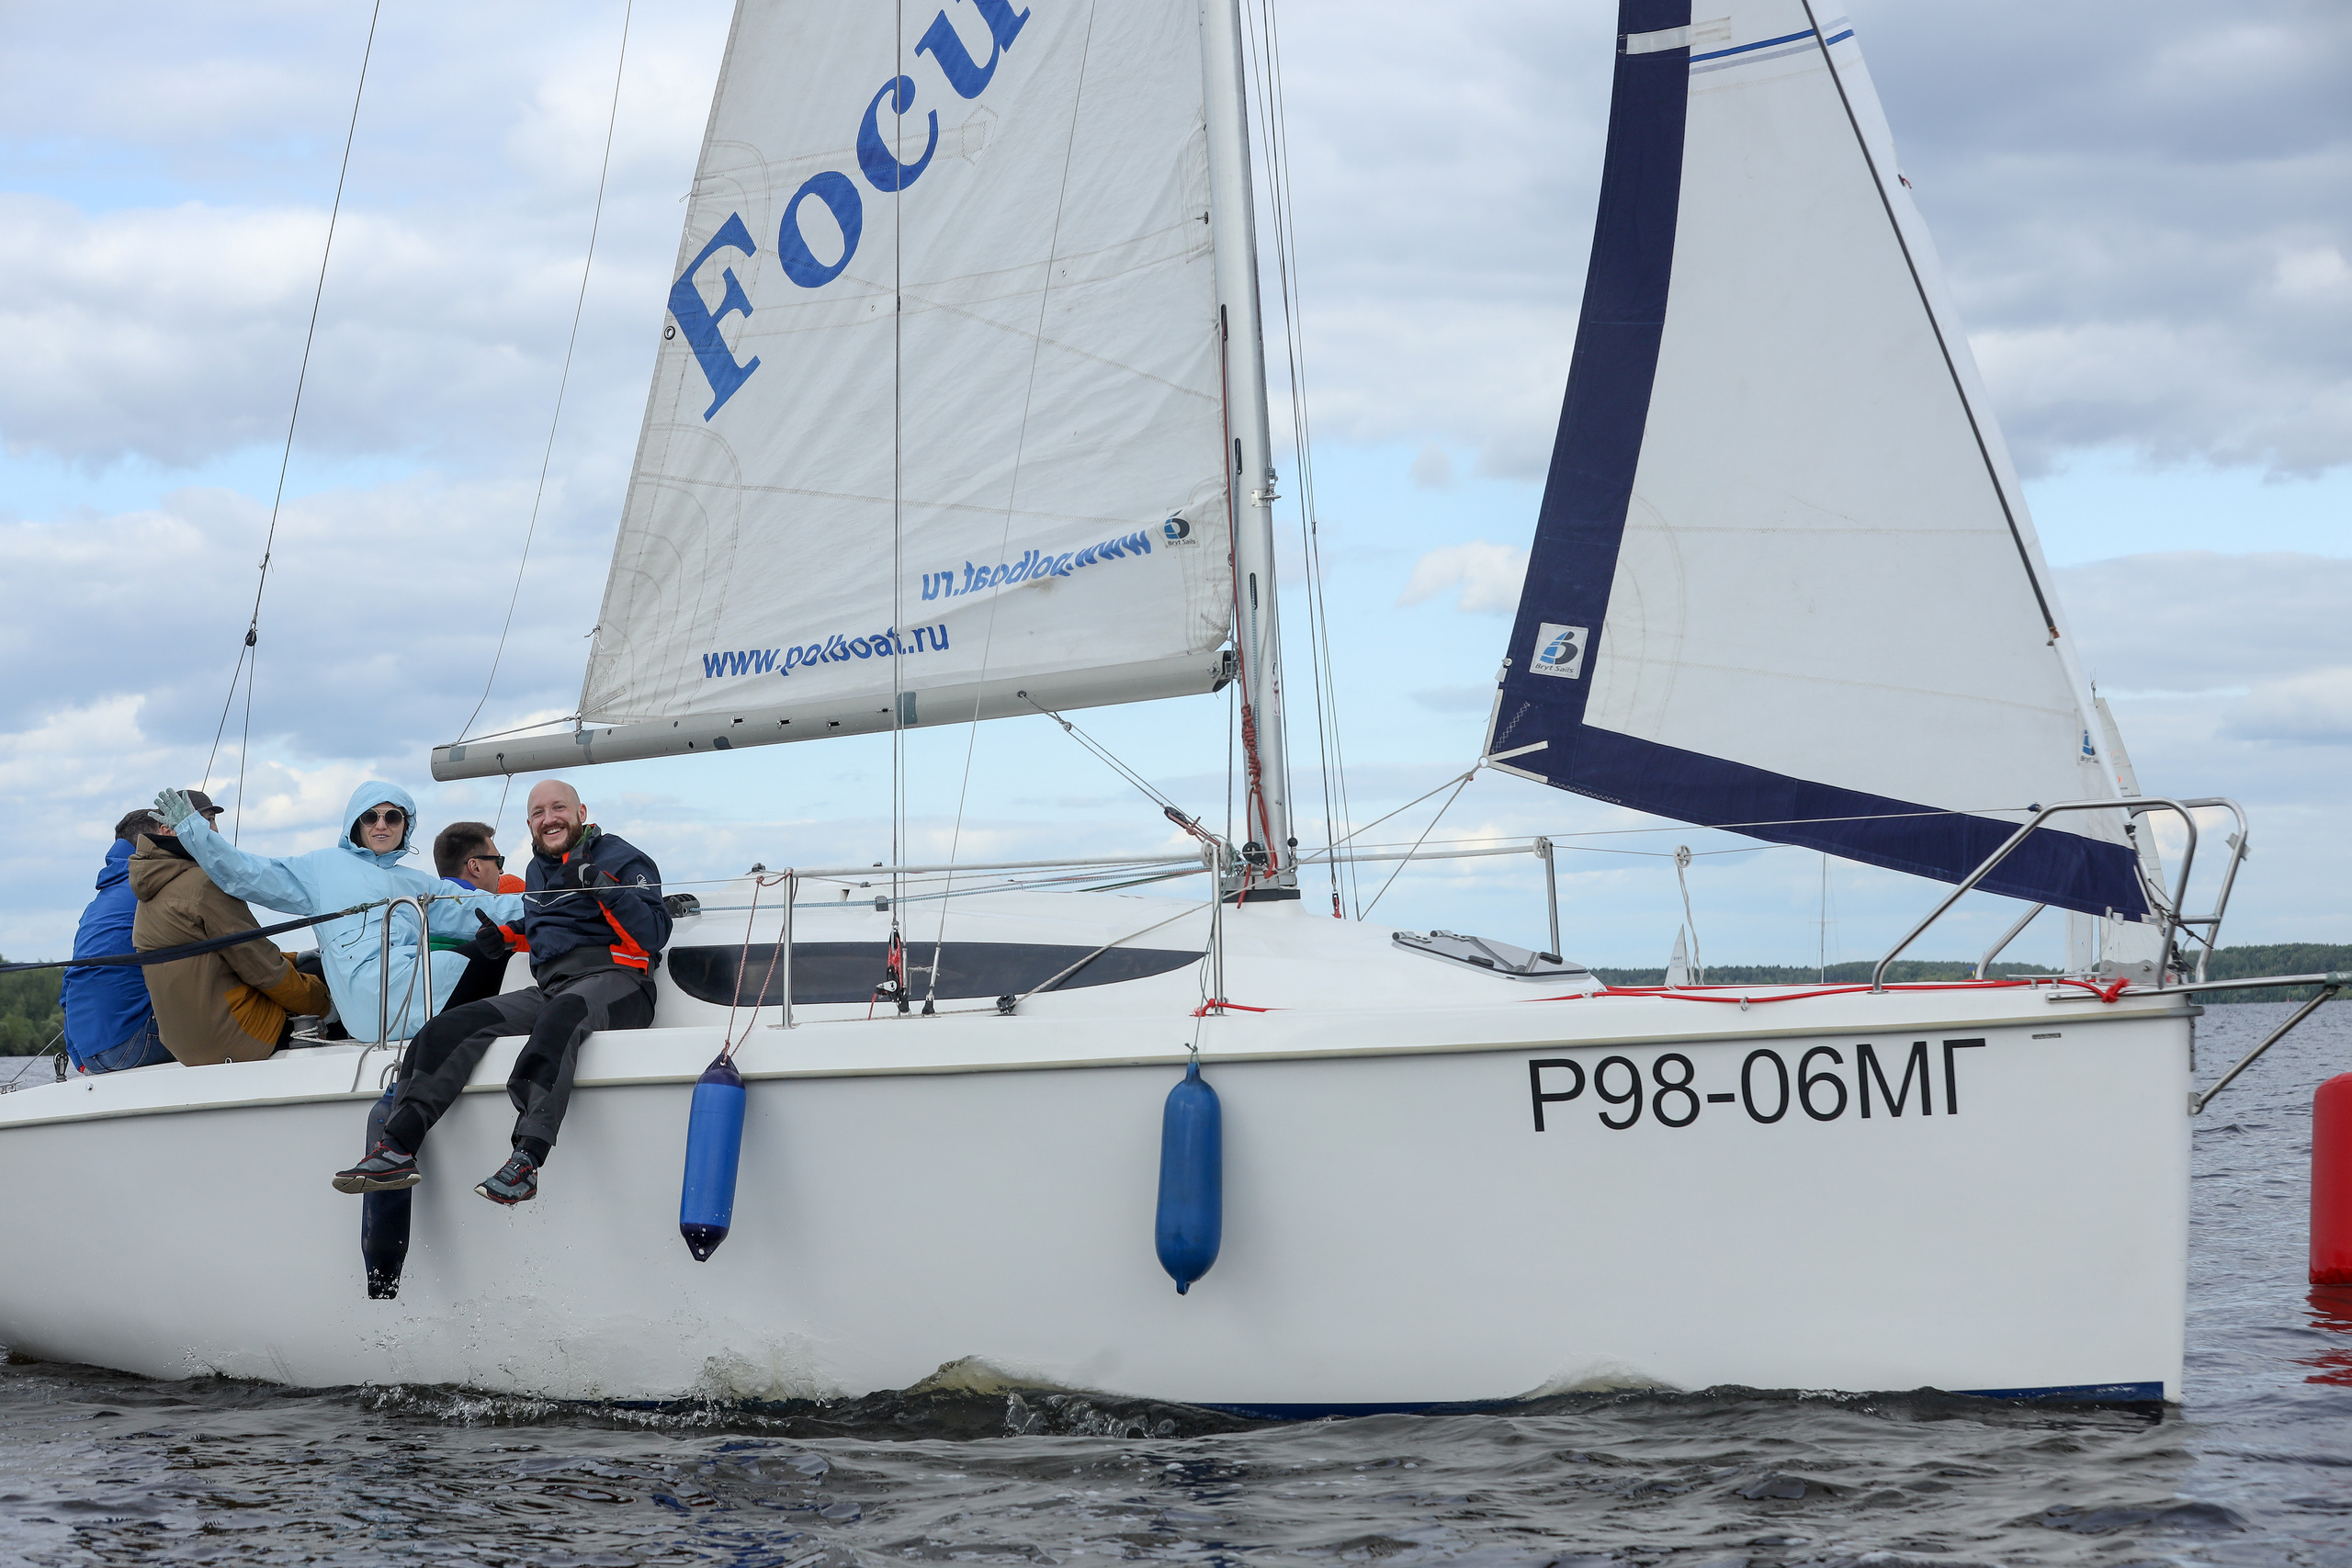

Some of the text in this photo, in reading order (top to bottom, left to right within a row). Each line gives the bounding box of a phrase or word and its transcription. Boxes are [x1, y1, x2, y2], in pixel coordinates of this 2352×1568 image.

[667, 0, 1032, 423] Focu
[703, 624, 950, 679] www.polboat.ru
[1534, 662, 1575, 673] Bryt Sails
[1529, 1038, 1986, 1132] Р98-06МГ
